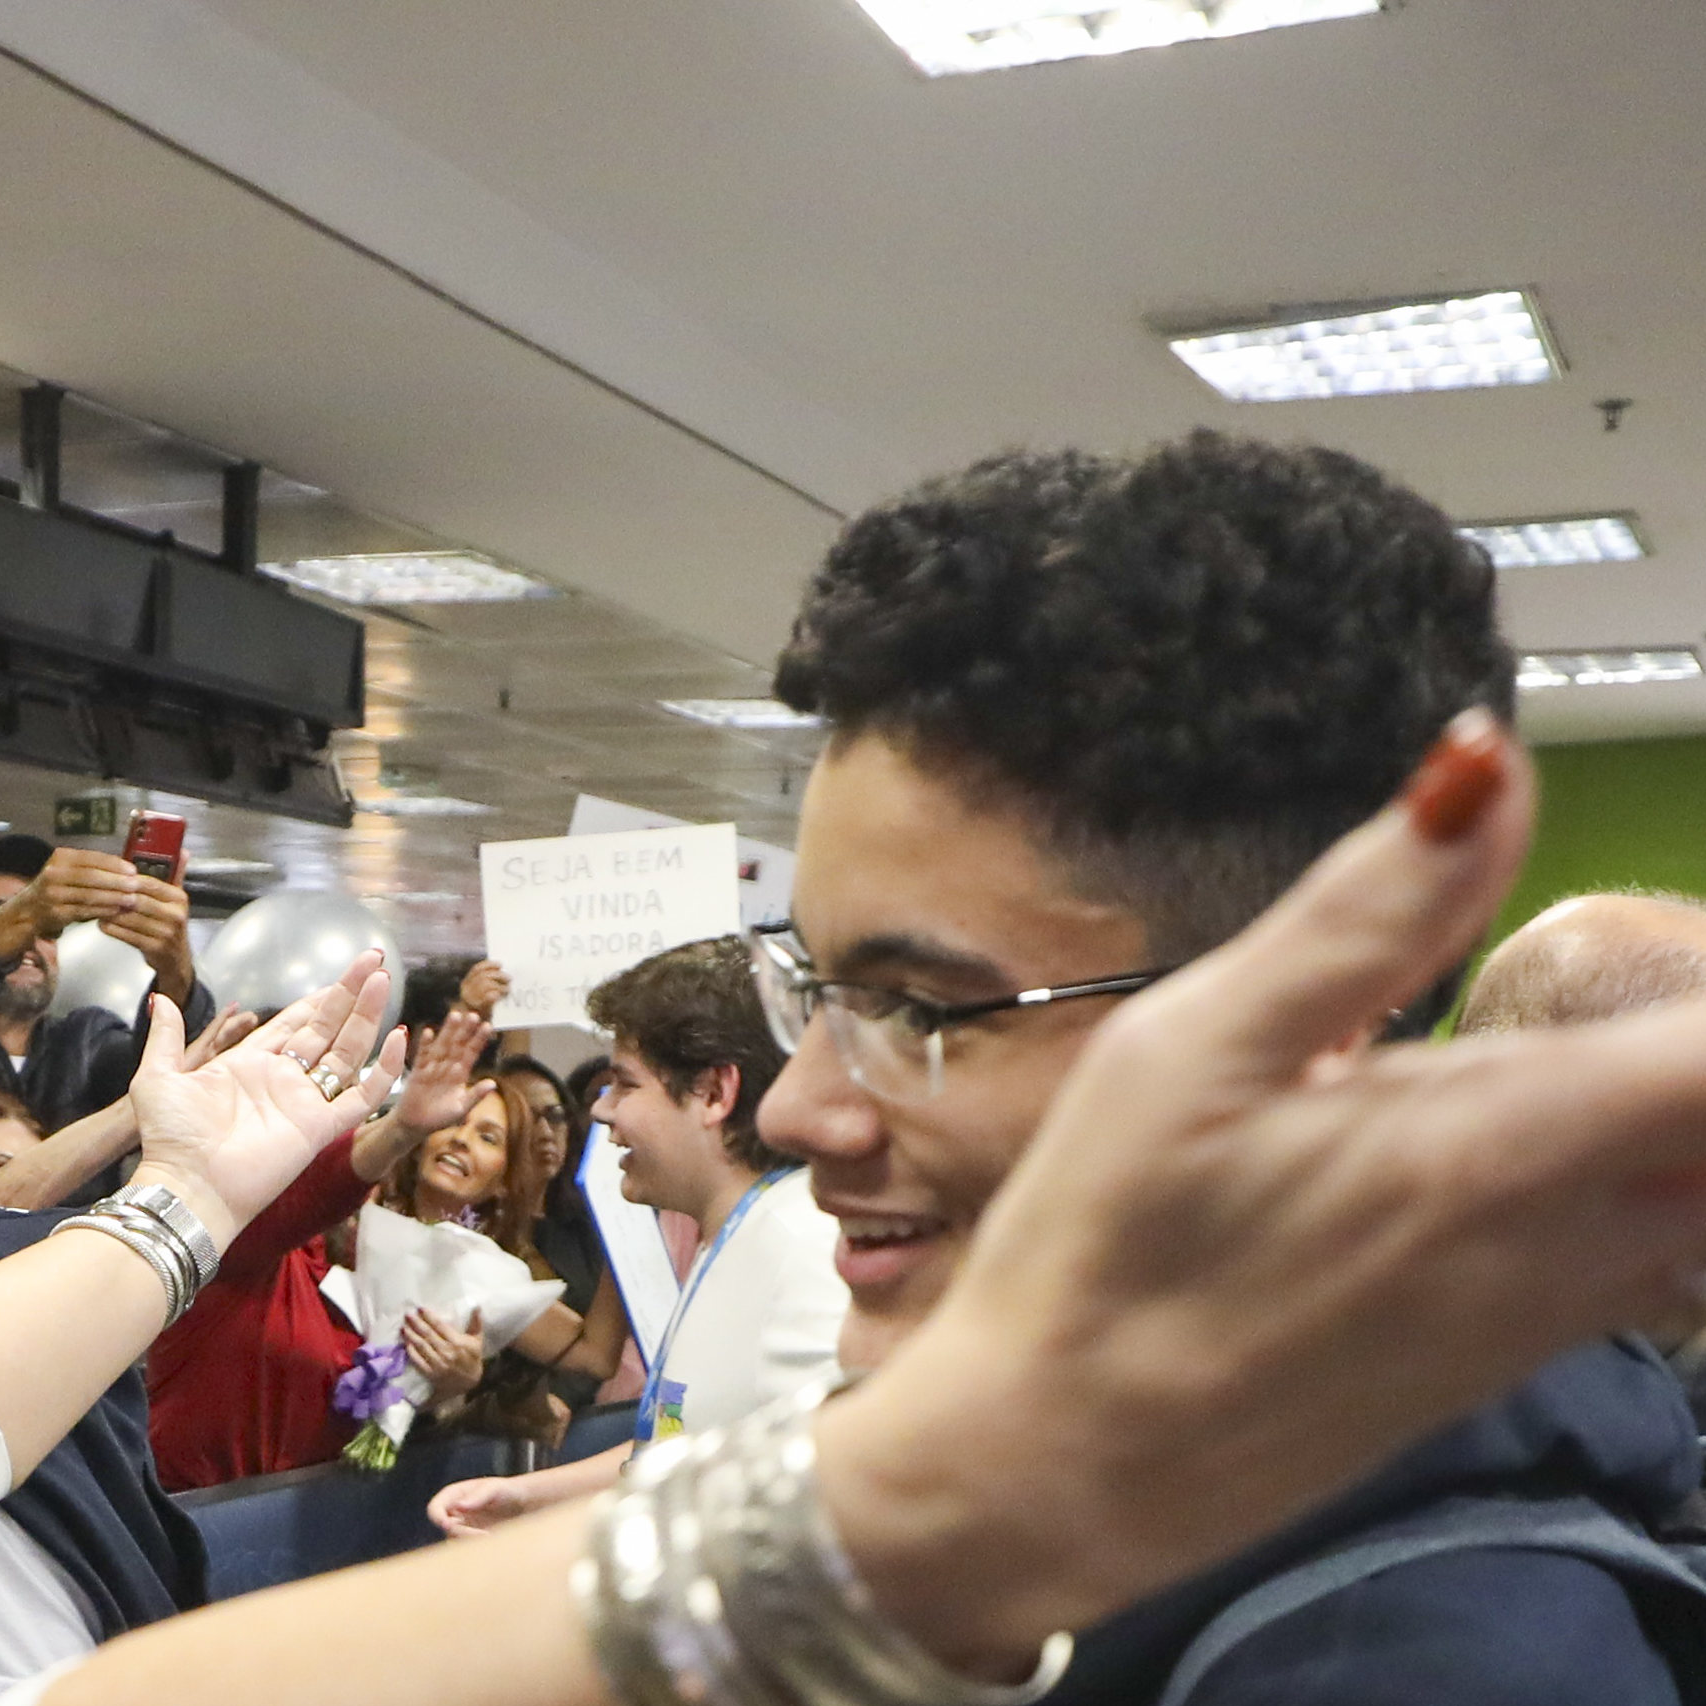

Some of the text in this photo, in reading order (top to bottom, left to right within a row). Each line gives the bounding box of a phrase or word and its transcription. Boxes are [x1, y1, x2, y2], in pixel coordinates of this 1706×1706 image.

[499, 845, 685, 891] SEJA BEM
[559, 888, 666, 921] VINDA
[537, 929, 665, 961] ISADORA
